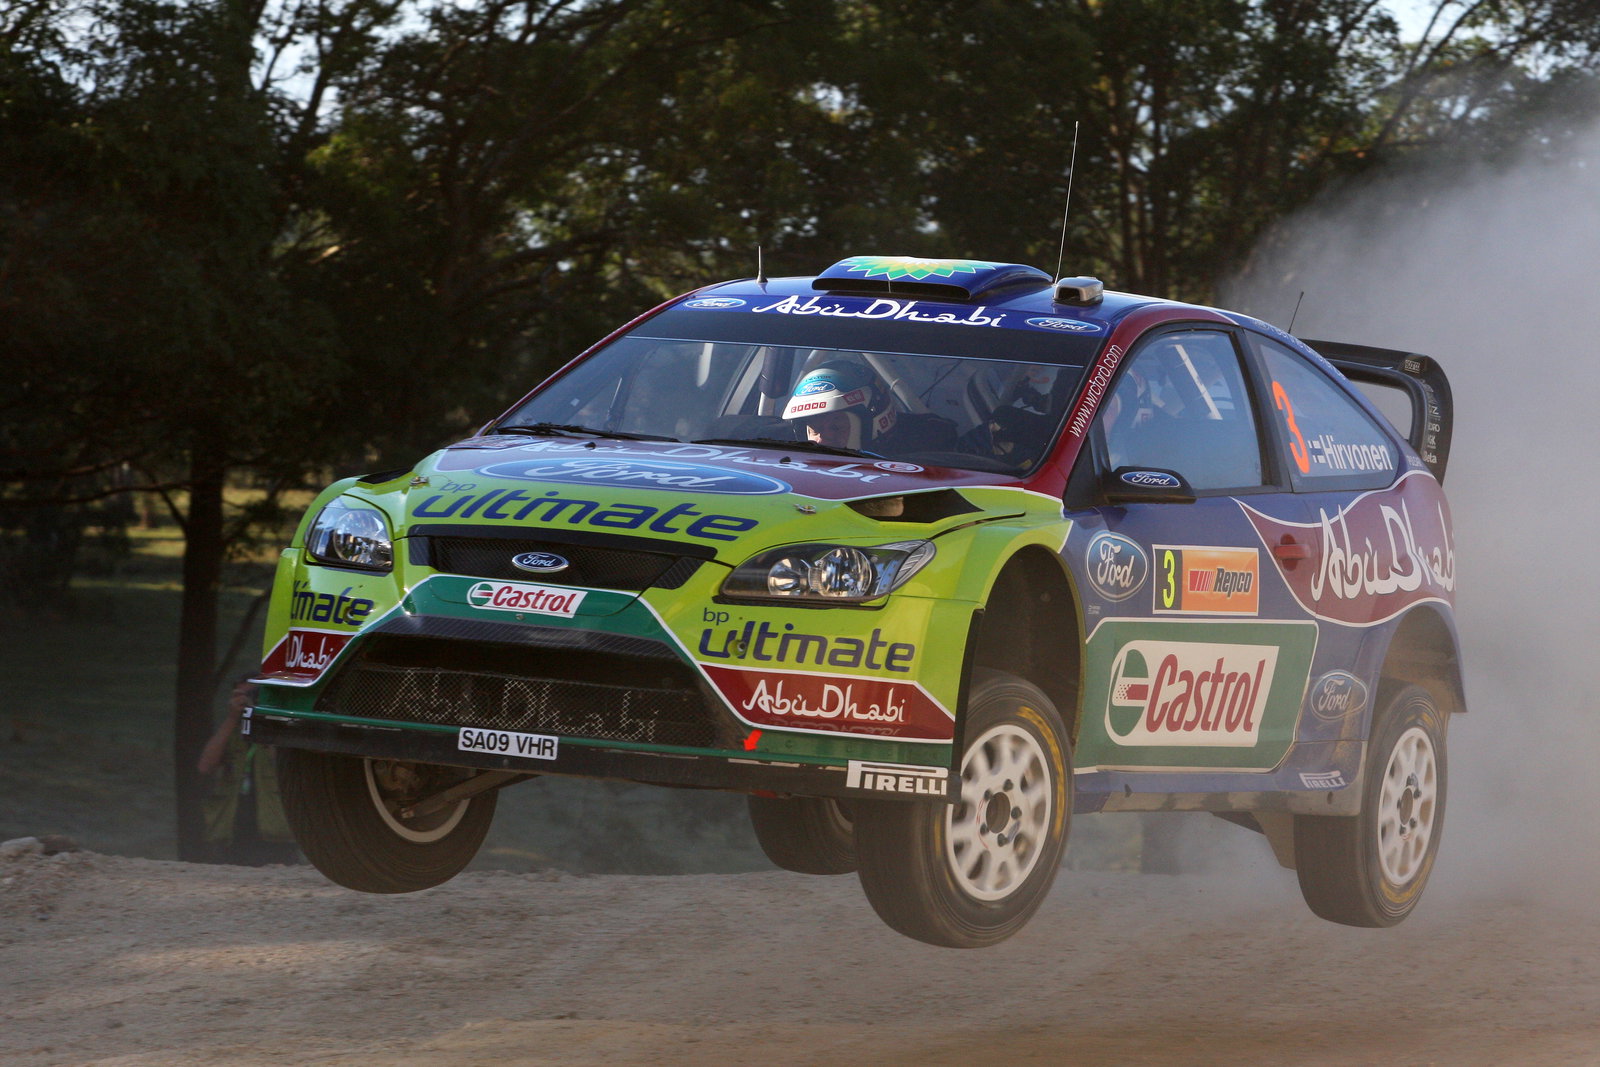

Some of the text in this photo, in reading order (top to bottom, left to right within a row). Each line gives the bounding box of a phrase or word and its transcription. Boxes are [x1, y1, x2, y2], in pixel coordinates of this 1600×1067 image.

[1038, 318, 1088, 331] Ford
[801, 381, 828, 394] Ford
[1069, 344, 1122, 437] www.wrcford.com
[1272, 381, 1310, 474] 3
[1319, 435, 1393, 470] Hirvonen
[440, 481, 477, 493] bp
[524, 459, 737, 488] Ford
[1131, 472, 1170, 486] Ford
[412, 488, 759, 541] ultimate
[522, 553, 557, 567] Ford
[1097, 540, 1135, 588] Ford
[1162, 550, 1175, 608] 3
[1213, 567, 1253, 598] Repco
[493, 585, 577, 613] Castrol
[703, 607, 729, 625] bp
[699, 620, 915, 672] ultimate
[1146, 653, 1266, 733] Castrol
[1318, 679, 1352, 711] Ford
[462, 729, 555, 757] SA09 VHR
[846, 760, 948, 796] PIRELLI
[1299, 770, 1346, 789] PIRELLI
